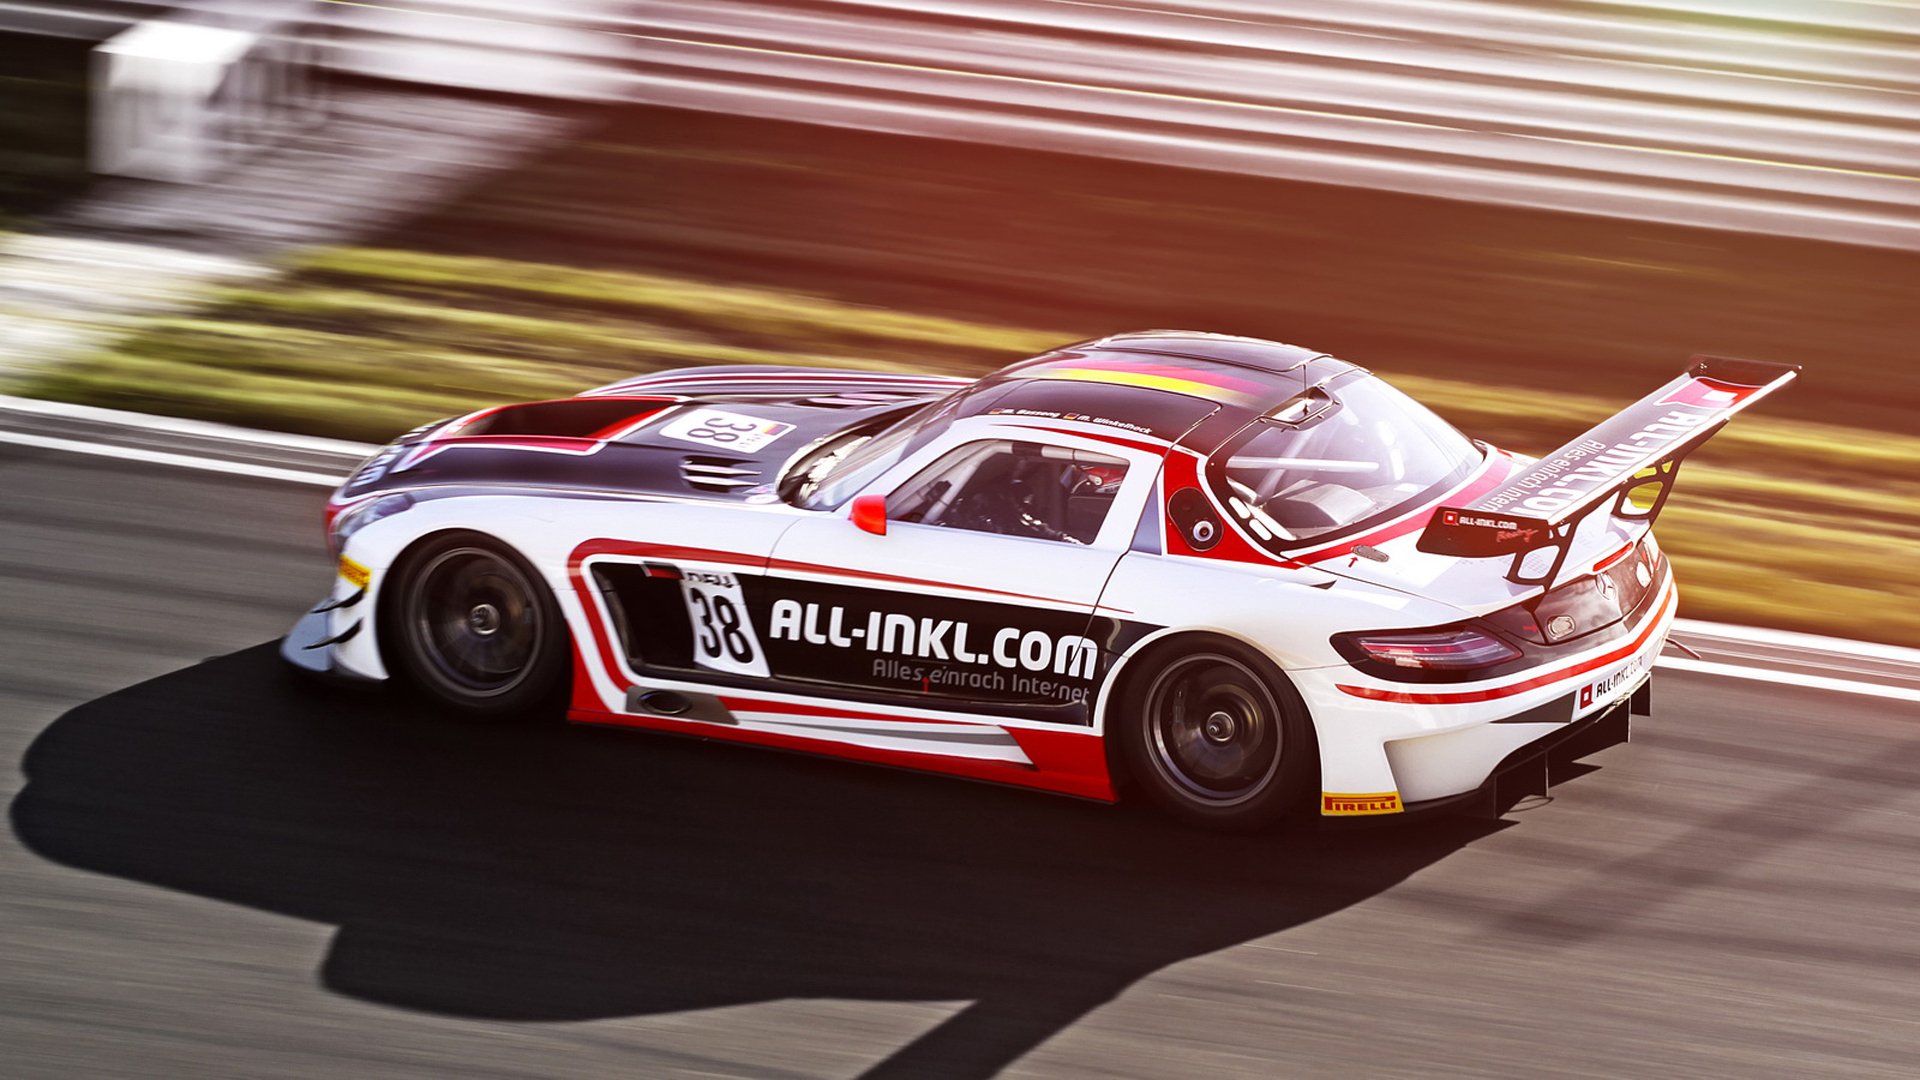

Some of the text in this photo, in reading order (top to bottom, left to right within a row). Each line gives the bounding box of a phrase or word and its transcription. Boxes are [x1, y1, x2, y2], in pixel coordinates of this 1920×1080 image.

[686, 417, 758, 443] 38
[1563, 439, 1607, 461] Alles
[1516, 458, 1571, 489] einfach
[690, 587, 754, 664] 38
[769, 598, 1099, 681] ALL-INKL.COM
[872, 658, 924, 682] Alles
[1324, 795, 1397, 812] PIRELLI
